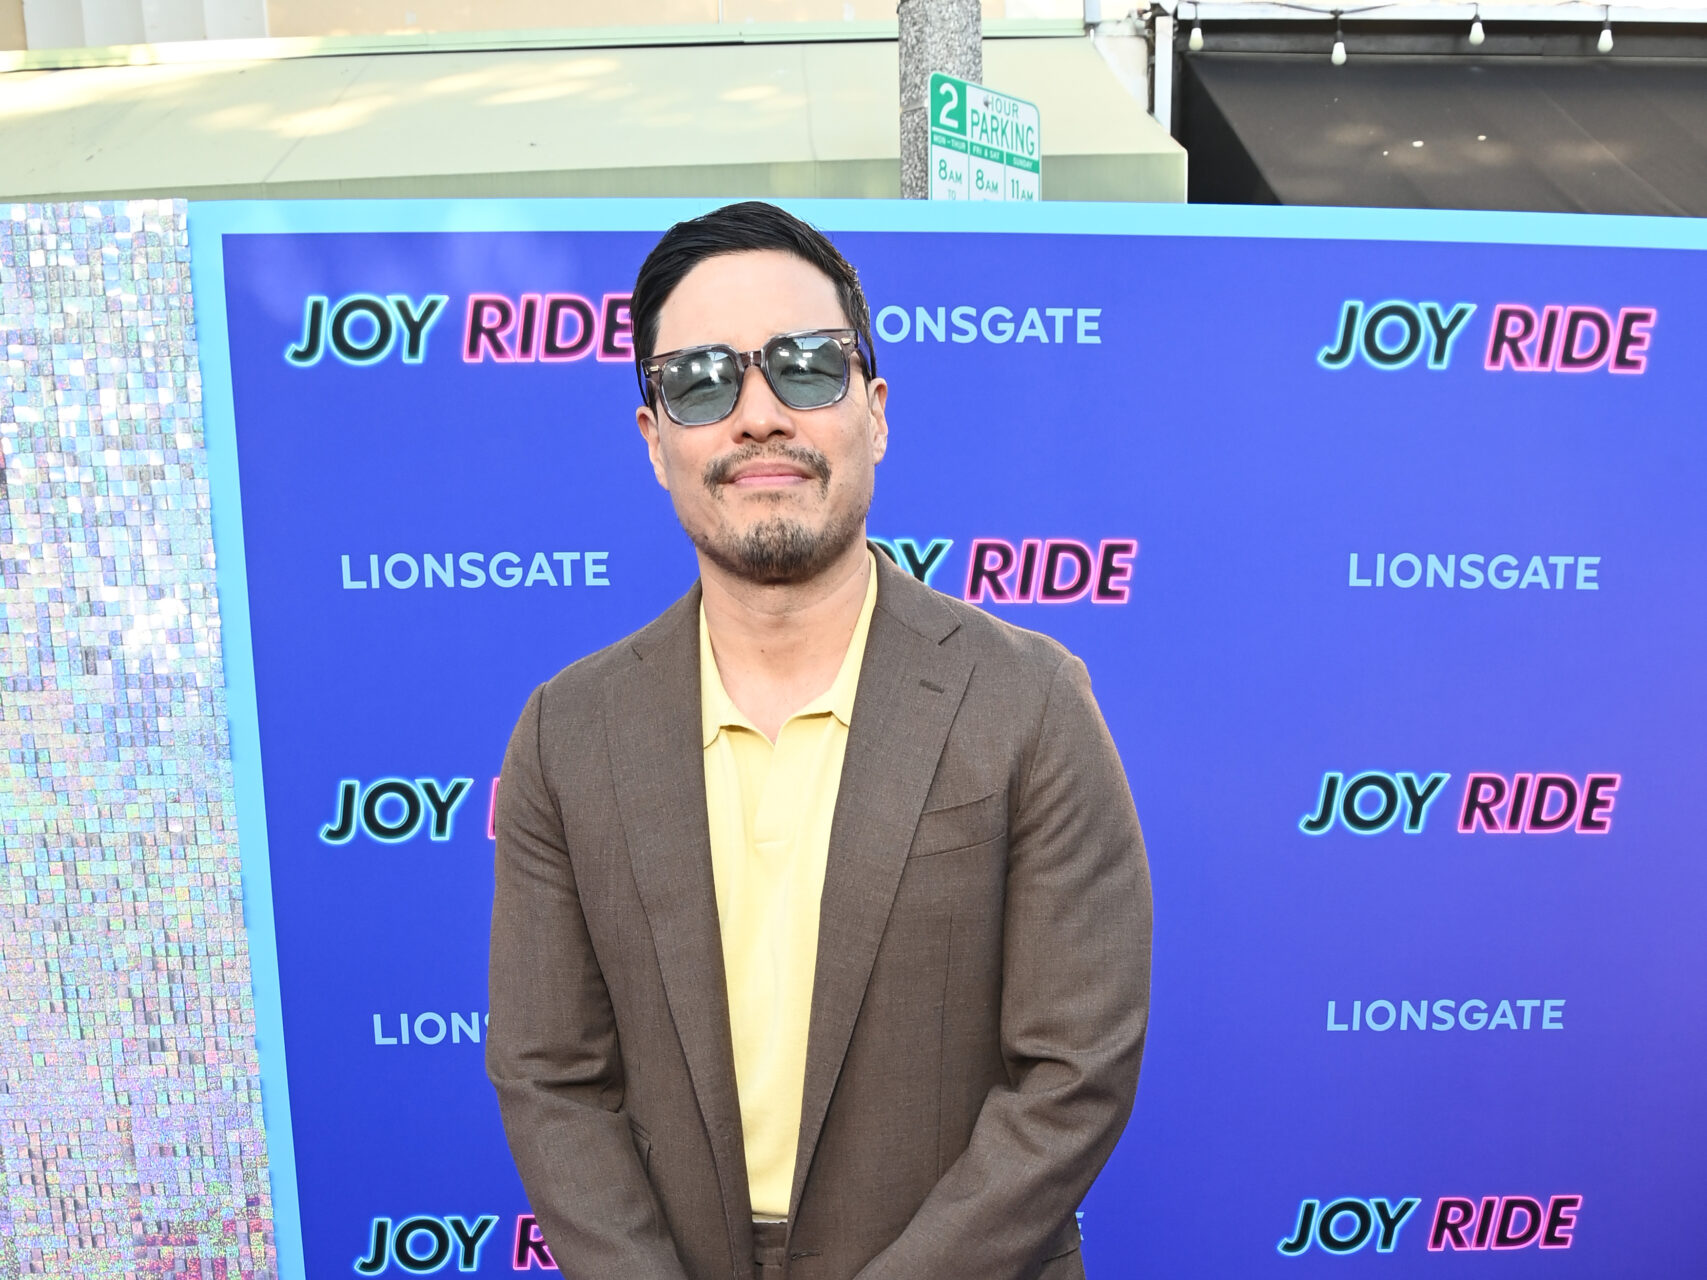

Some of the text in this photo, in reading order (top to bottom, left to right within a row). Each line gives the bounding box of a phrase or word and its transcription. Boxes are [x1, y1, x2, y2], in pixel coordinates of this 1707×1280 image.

[938, 82, 959, 129] 2
[970, 109, 1035, 156] PARKING
[1012, 156, 1034, 170] SUNDAY
[285, 293, 636, 367] JOY RIDE
[869, 305, 1103, 345] ONSGATE
[1317, 299, 1658, 375] JOY RIDE
[341, 551, 611, 590] LIONSGATE
[964, 538, 1138, 604] RIDE
[1348, 552, 1602, 590] LIONSGATE
[320, 778, 474, 845] JOY
[1299, 771, 1621, 835] JOY RIDE
[373, 1011, 489, 1045] LION
[1326, 999, 1567, 1032] LIONSGATE
[354, 1215, 499, 1275] JOY
[1277, 1195, 1583, 1256] JOY RIDE
